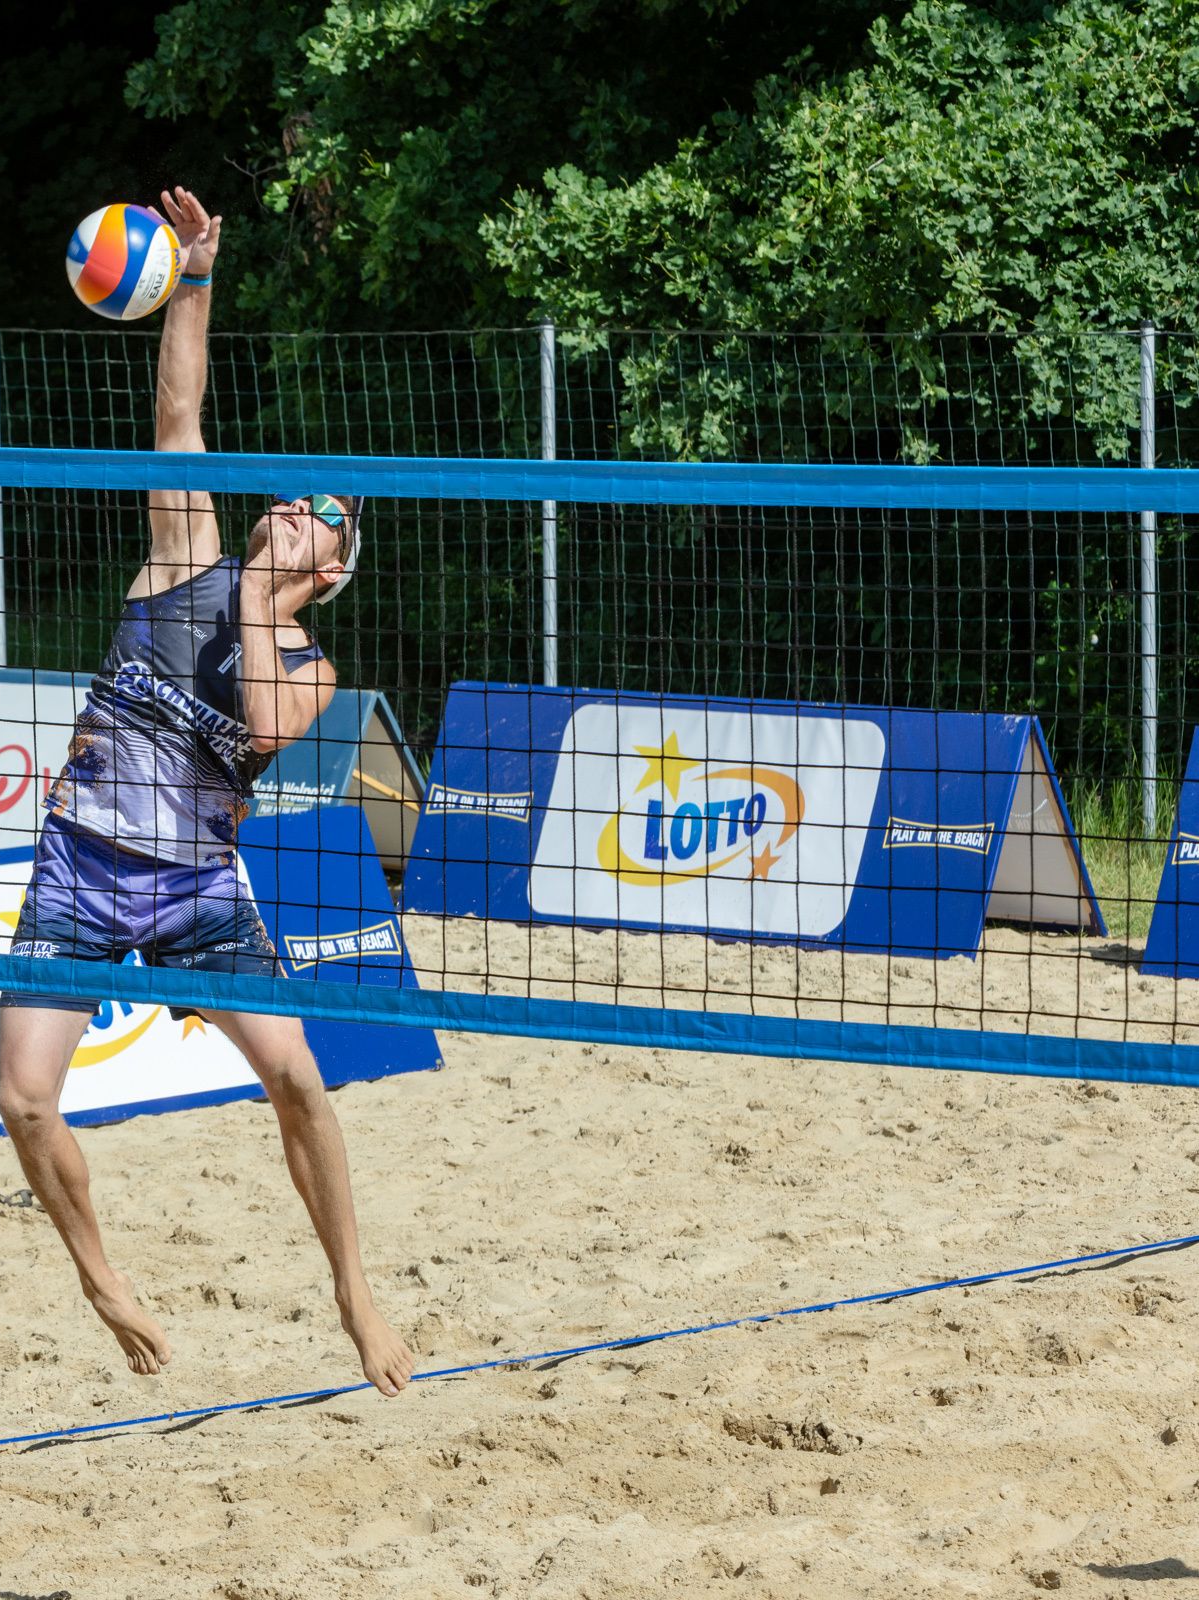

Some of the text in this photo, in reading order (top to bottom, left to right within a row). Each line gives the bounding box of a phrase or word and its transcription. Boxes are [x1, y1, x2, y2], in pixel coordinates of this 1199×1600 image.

[433, 791, 459, 808] PLAY
[460, 796, 475, 809] ON
[495, 798, 527, 815] BEACH
[644, 792, 767, 861] LOTTO
[891, 824, 917, 842] PLAY
[917, 827, 932, 842] ON
[954, 830, 987, 848] BEACH
[292, 929, 393, 960] PLAY ON THE BEACH
